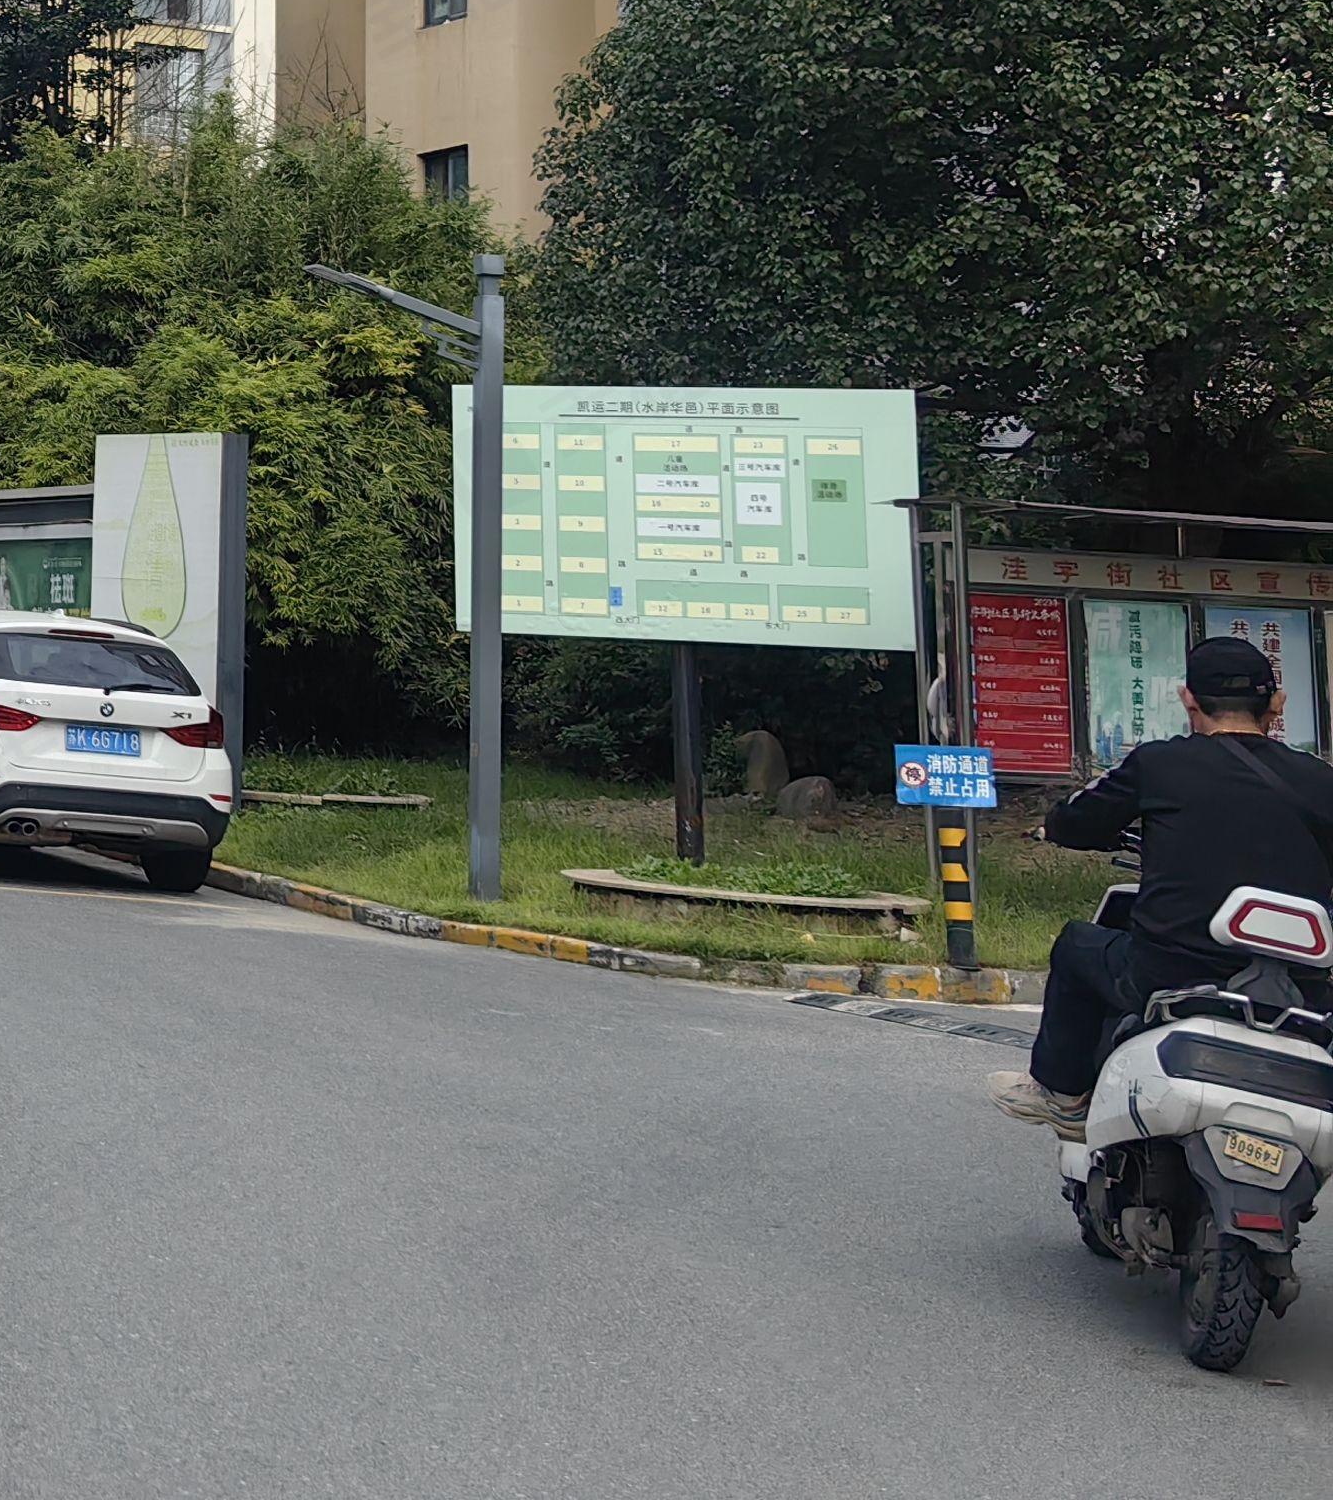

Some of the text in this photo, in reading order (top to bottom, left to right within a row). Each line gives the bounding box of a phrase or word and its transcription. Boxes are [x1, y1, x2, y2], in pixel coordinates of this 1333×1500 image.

[926, 754, 990, 776] 消防通道
[927, 776, 990, 798] 禁止占用
